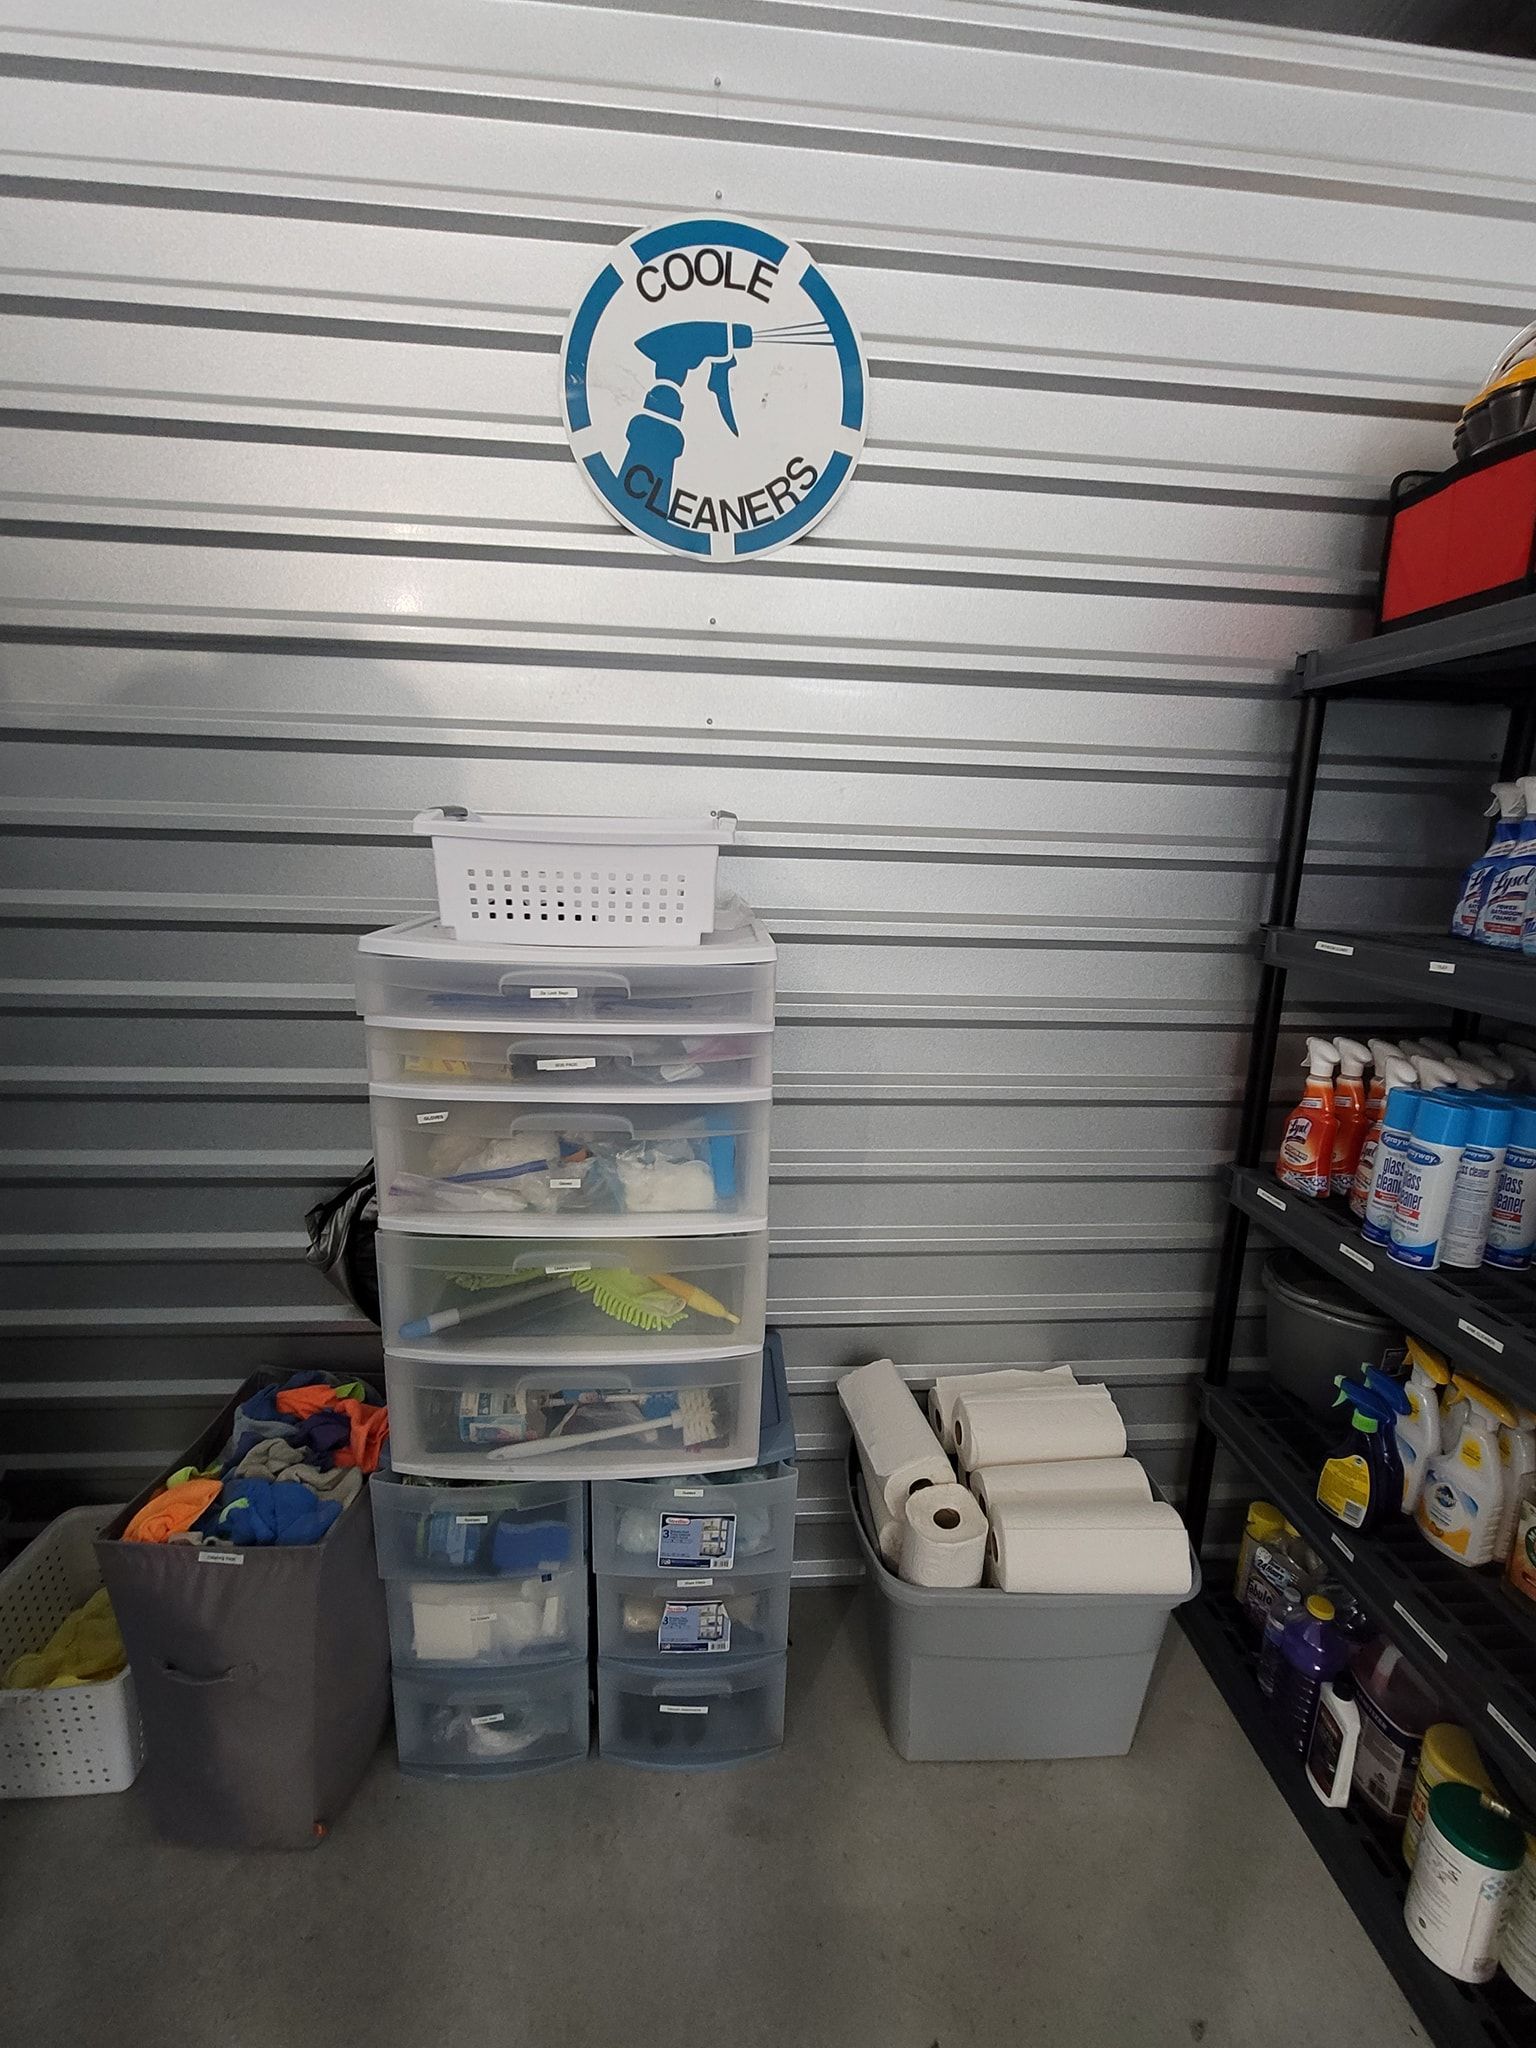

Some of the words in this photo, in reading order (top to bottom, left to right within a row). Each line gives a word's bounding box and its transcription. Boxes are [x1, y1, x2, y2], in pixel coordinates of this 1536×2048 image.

[636, 249, 779, 304] COOLE
[624, 457, 818, 533] CLEANERS
[1492, 866, 1536, 895] Lysol
[662, 1529, 670, 1539] 3
[1257, 1559, 1268, 1571] 24
[662, 1616, 669, 1626] 3
